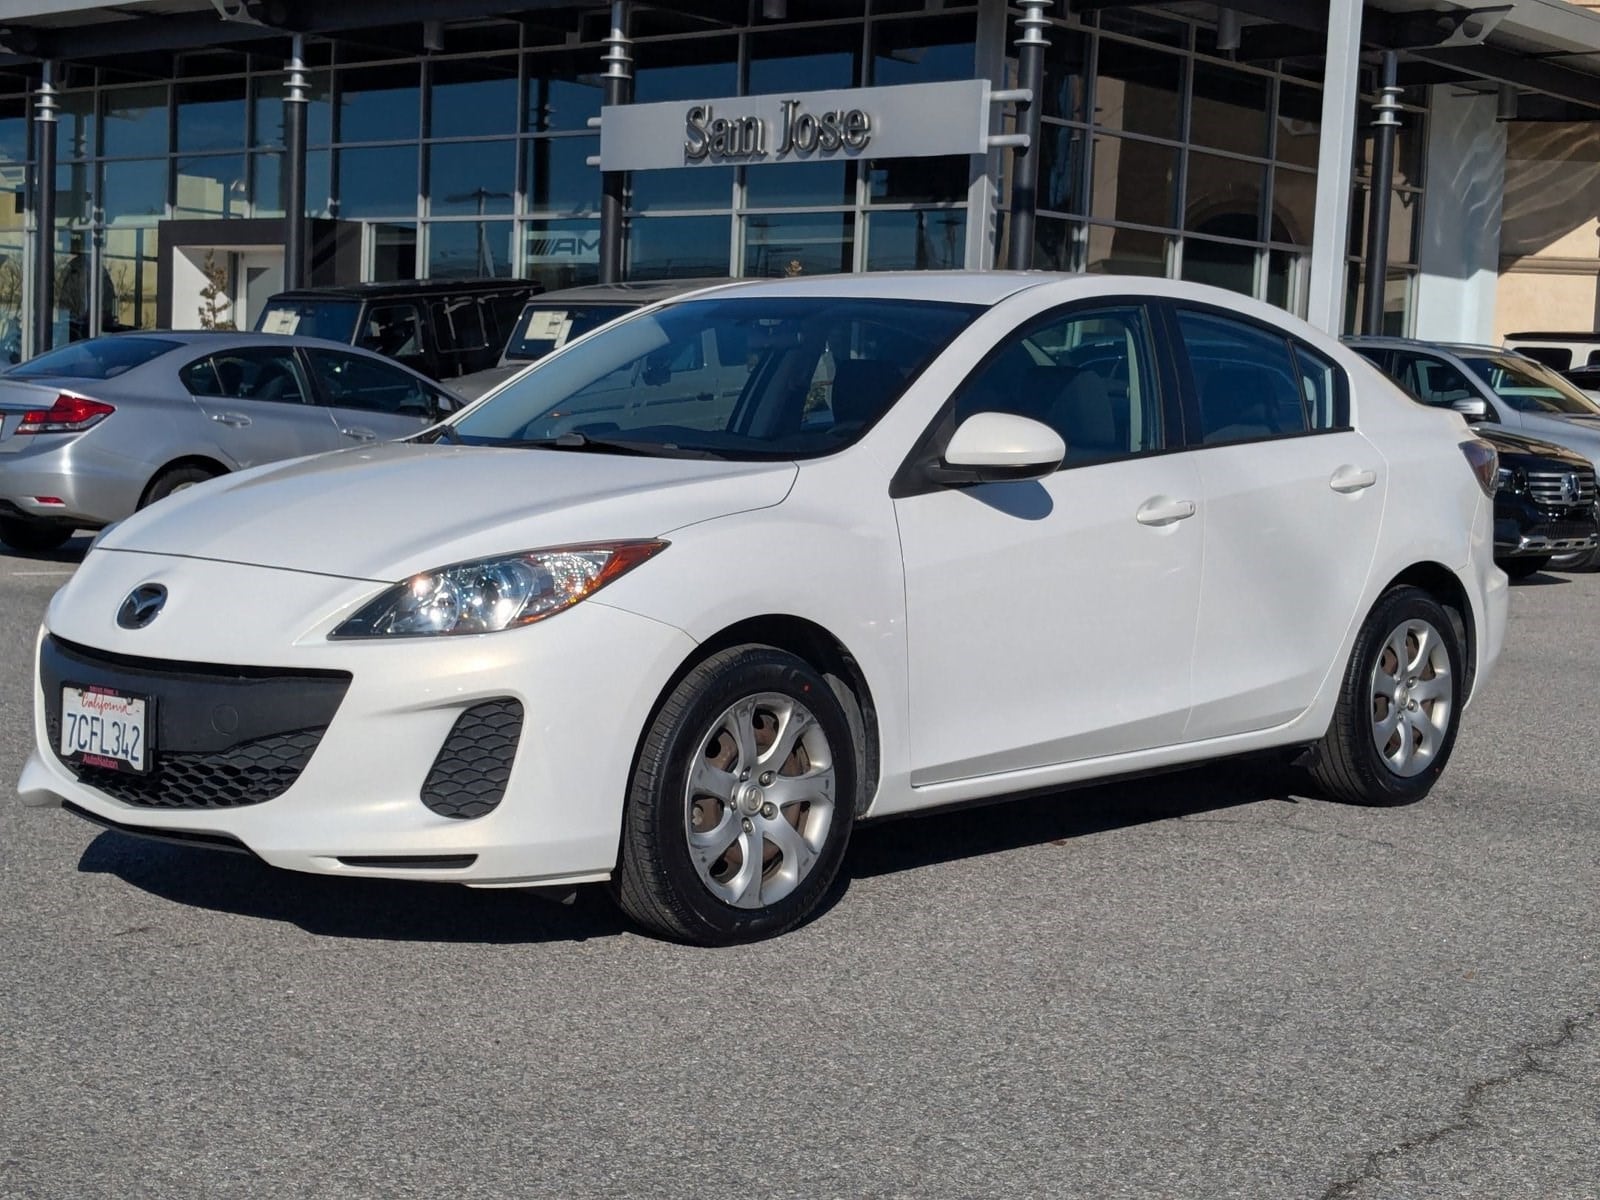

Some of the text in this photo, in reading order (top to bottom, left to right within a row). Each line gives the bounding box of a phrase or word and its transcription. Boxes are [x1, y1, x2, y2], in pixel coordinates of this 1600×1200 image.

[685, 100, 871, 162] San Jose
[81, 692, 132, 716] California
[67, 712, 140, 762] 7CFL342
